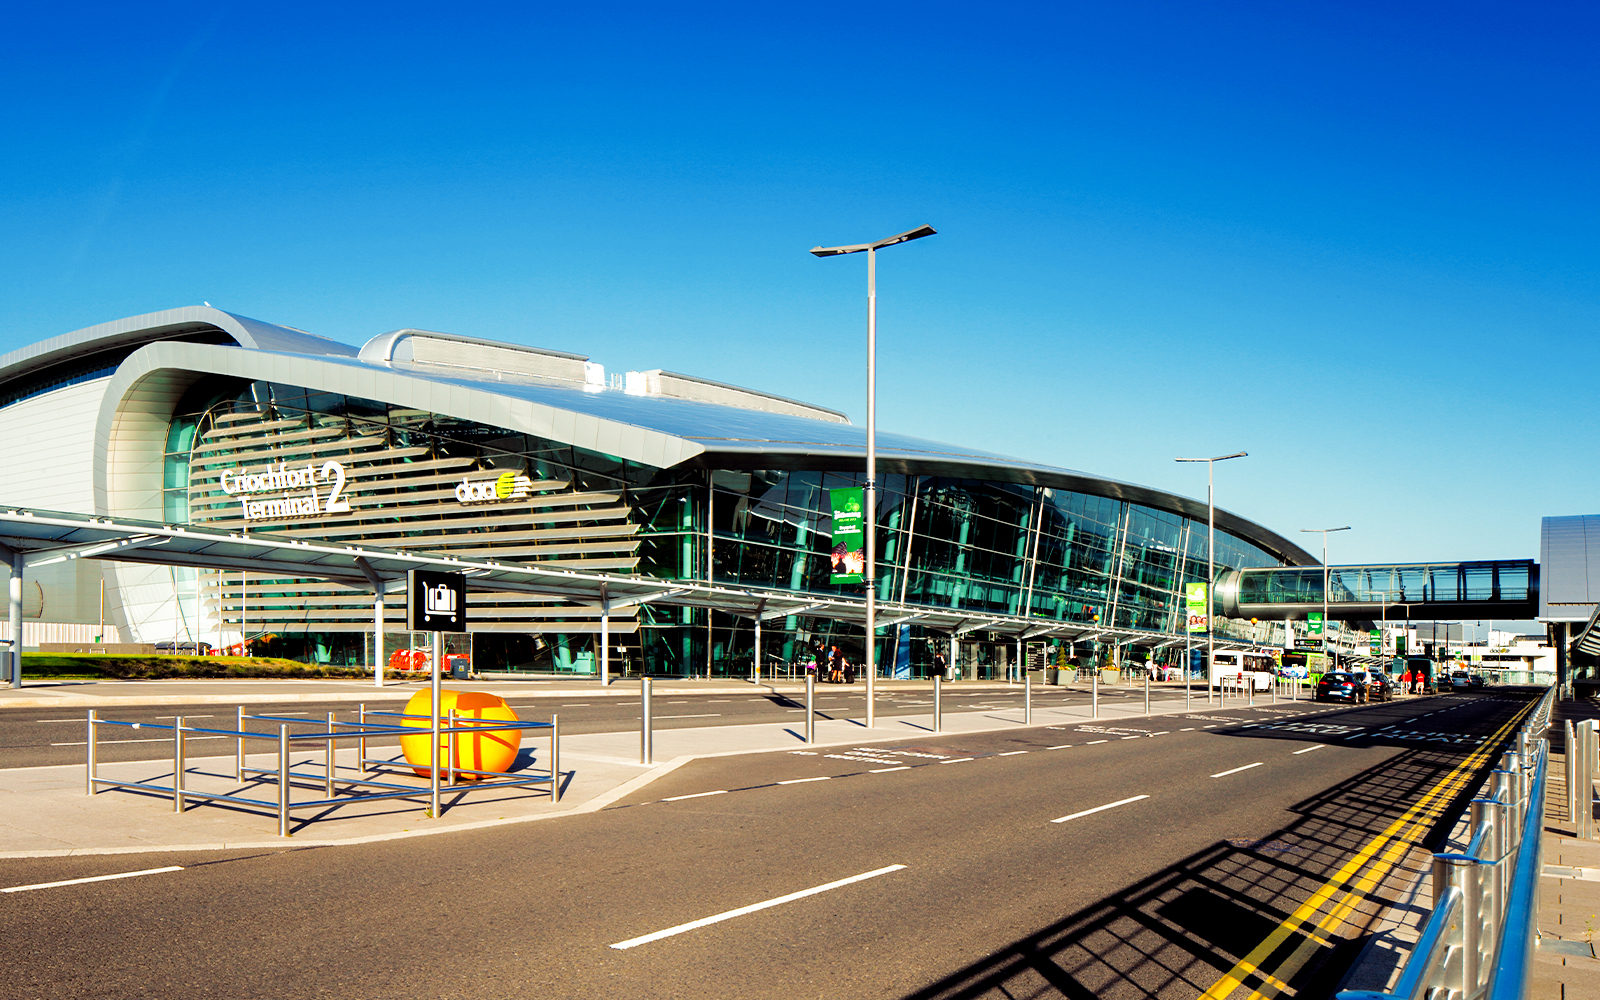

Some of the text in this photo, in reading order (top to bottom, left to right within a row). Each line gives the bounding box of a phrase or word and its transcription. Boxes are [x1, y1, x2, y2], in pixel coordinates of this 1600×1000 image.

[220, 462, 318, 494] Críochfort
[320, 460, 350, 512] 2
[237, 487, 321, 519] Terminal
